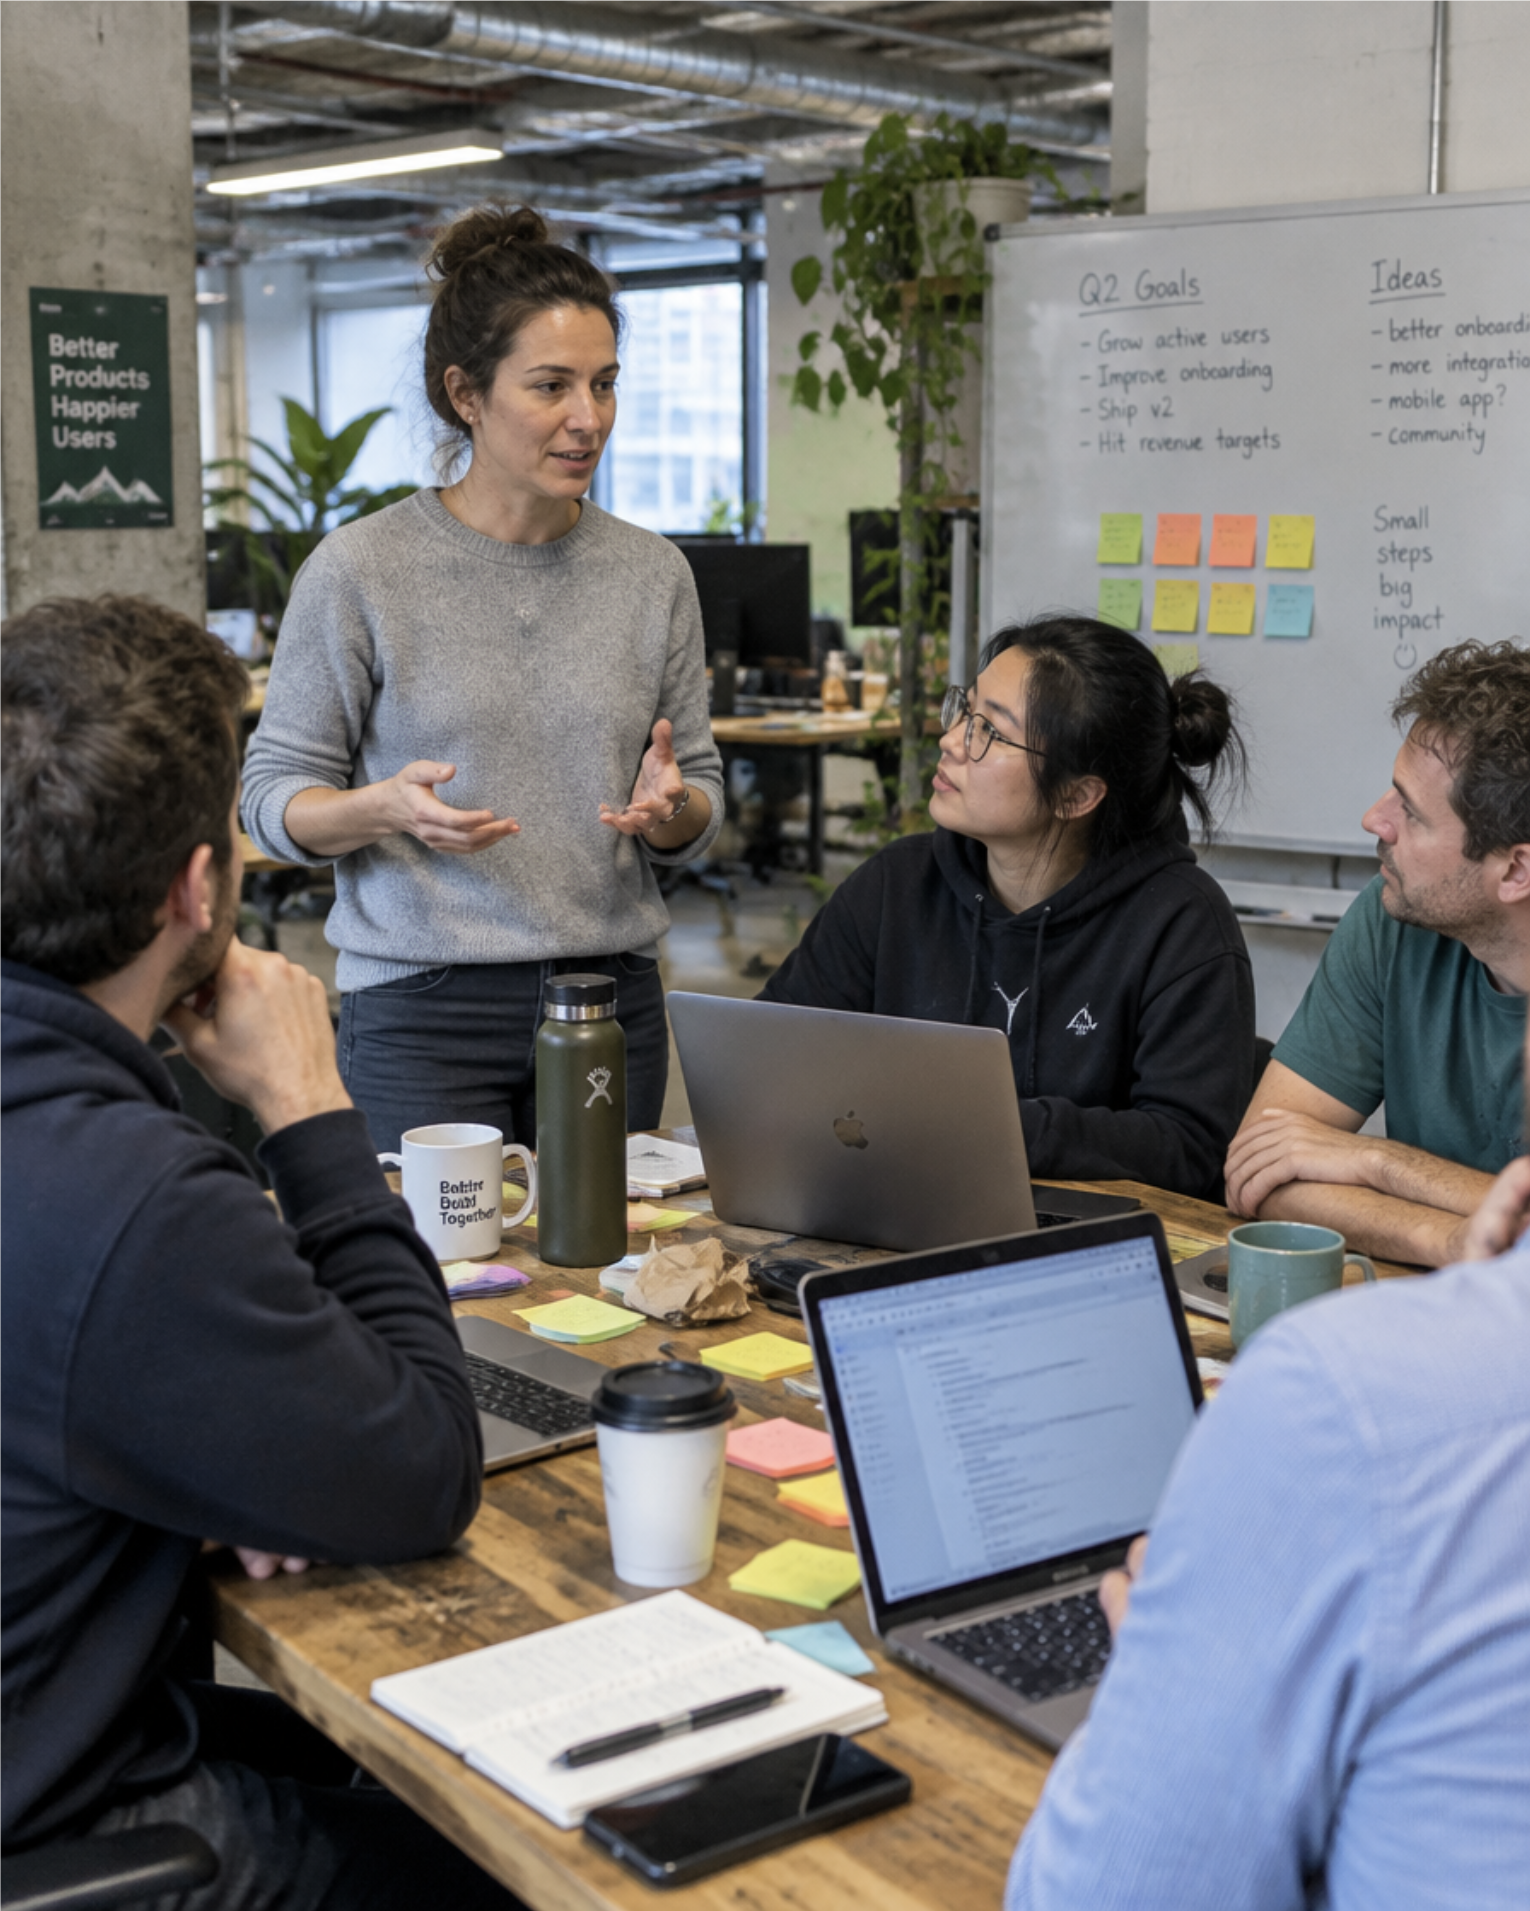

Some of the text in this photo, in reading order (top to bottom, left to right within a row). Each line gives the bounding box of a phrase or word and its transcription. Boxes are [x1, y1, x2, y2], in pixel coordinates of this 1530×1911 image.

[1079, 267, 1201, 306] Q2 Goals
[1370, 258, 1444, 294] Ideas
[1098, 328, 1143, 353] Grow
[1155, 326, 1207, 349] active
[1221, 328, 1270, 344] users
[1389, 317, 1443, 342] better
[49, 333, 118, 360] Better
[50, 363, 150, 390] Products
[1098, 364, 1167, 395] Improve
[1180, 357, 1273, 392] onboarding
[1389, 359, 1432, 375] more
[1446, 350, 1530, 383] integratio
[52, 395, 140, 424] Happier
[1098, 398, 1138, 427] Ship
[1150, 395, 1175, 418] v2
[1389, 388, 1446, 410] mobile
[1459, 383, 1507, 419] app?
[53, 426, 116, 449] Users
[1098, 431, 1126, 453] Hit
[1140, 436, 1203, 451] revenue
[1216, 426, 1281, 460] targets
[1373, 504, 1429, 532] Small
[1377, 540, 1433, 572] steps
[1380, 572, 1413, 609] big
[1373, 605, 1445, 639] impact
